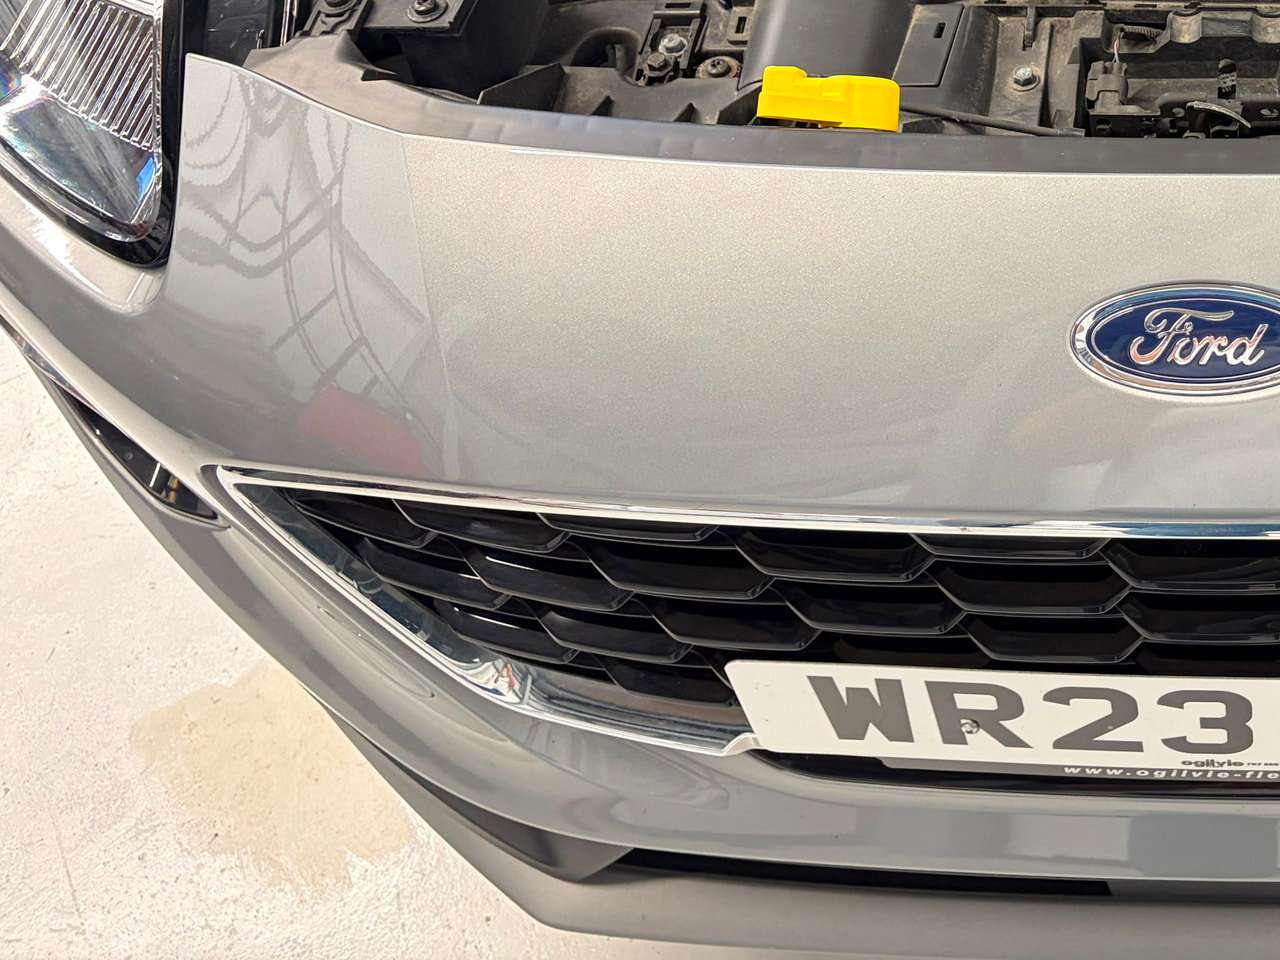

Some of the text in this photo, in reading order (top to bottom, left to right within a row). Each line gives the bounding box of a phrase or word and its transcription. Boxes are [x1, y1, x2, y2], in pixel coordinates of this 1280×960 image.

[1129, 307, 1269, 366] Ford
[805, 675, 1255, 755] WR23
[1181, 759, 1245, 769] ogilvie
